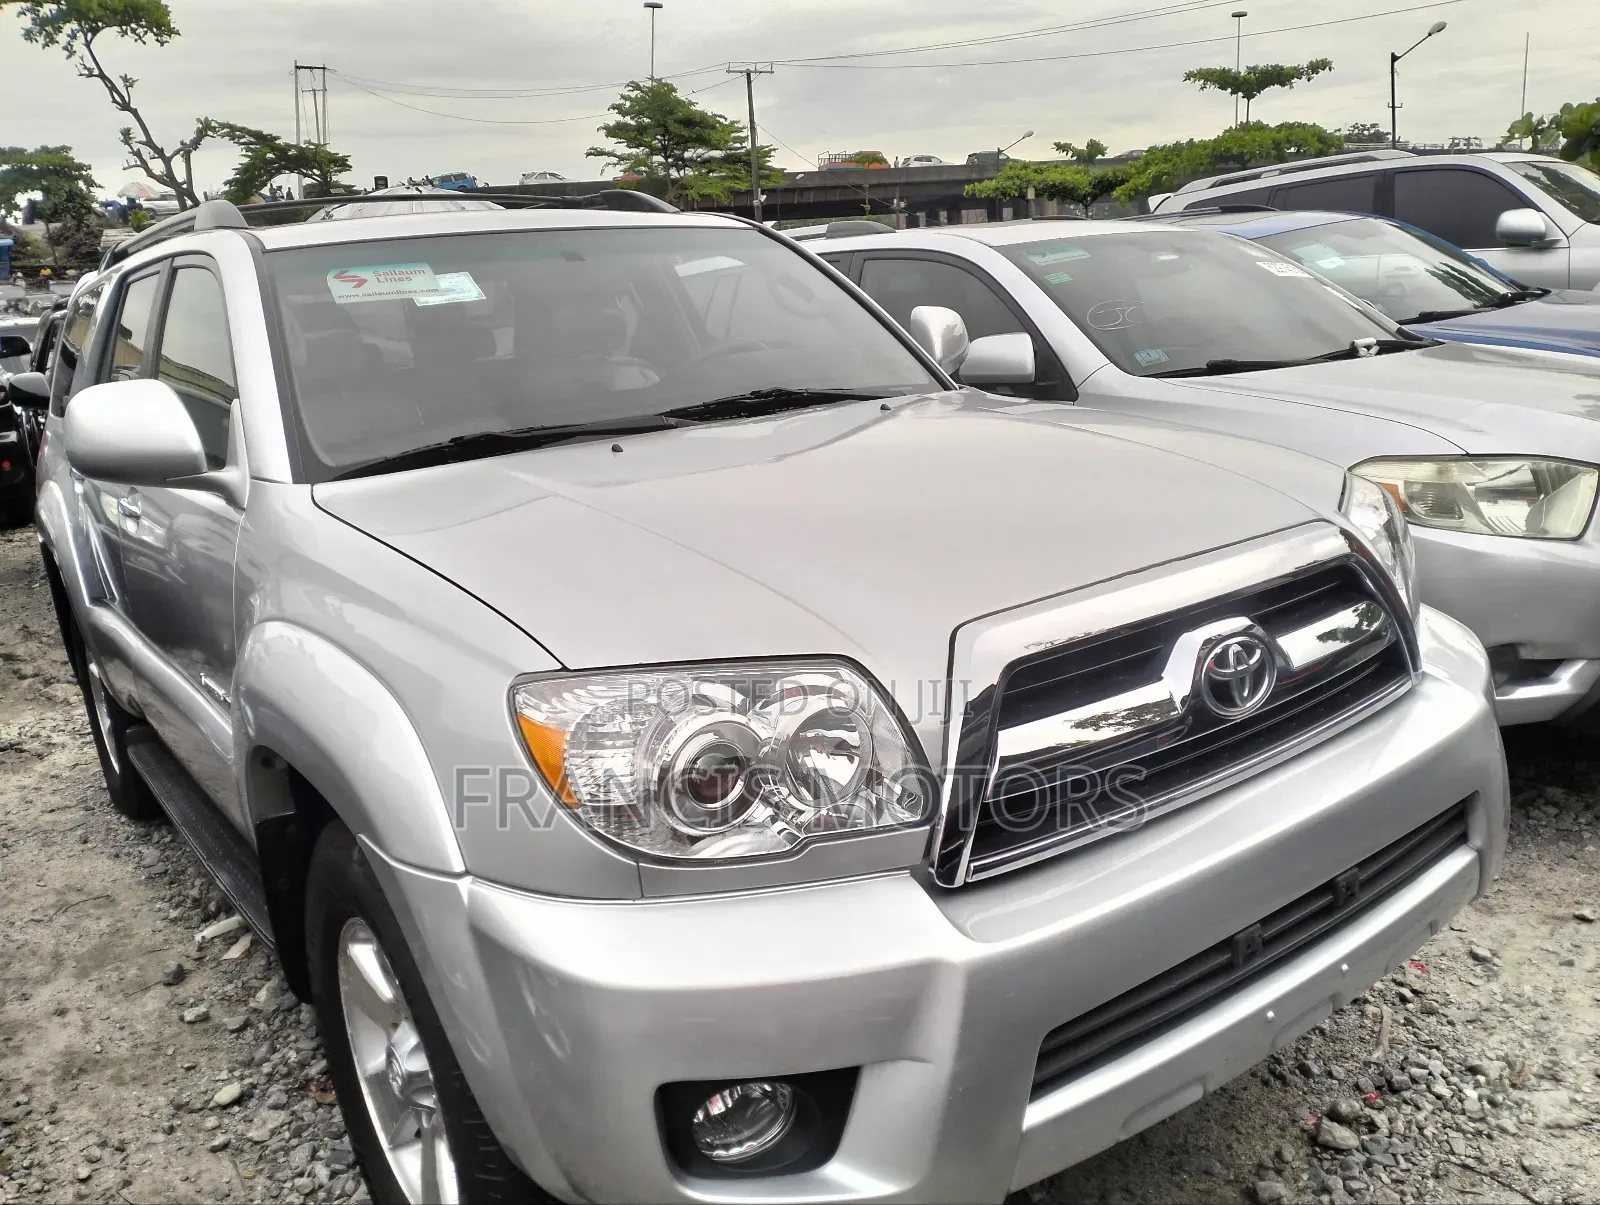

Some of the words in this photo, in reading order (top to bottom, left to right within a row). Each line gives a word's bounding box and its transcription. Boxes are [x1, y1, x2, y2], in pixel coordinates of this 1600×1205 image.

[373, 269, 425, 277] Sallaum
[376, 275, 412, 283] Lines
[338, 288, 440, 299] www.sallaumlines.com
